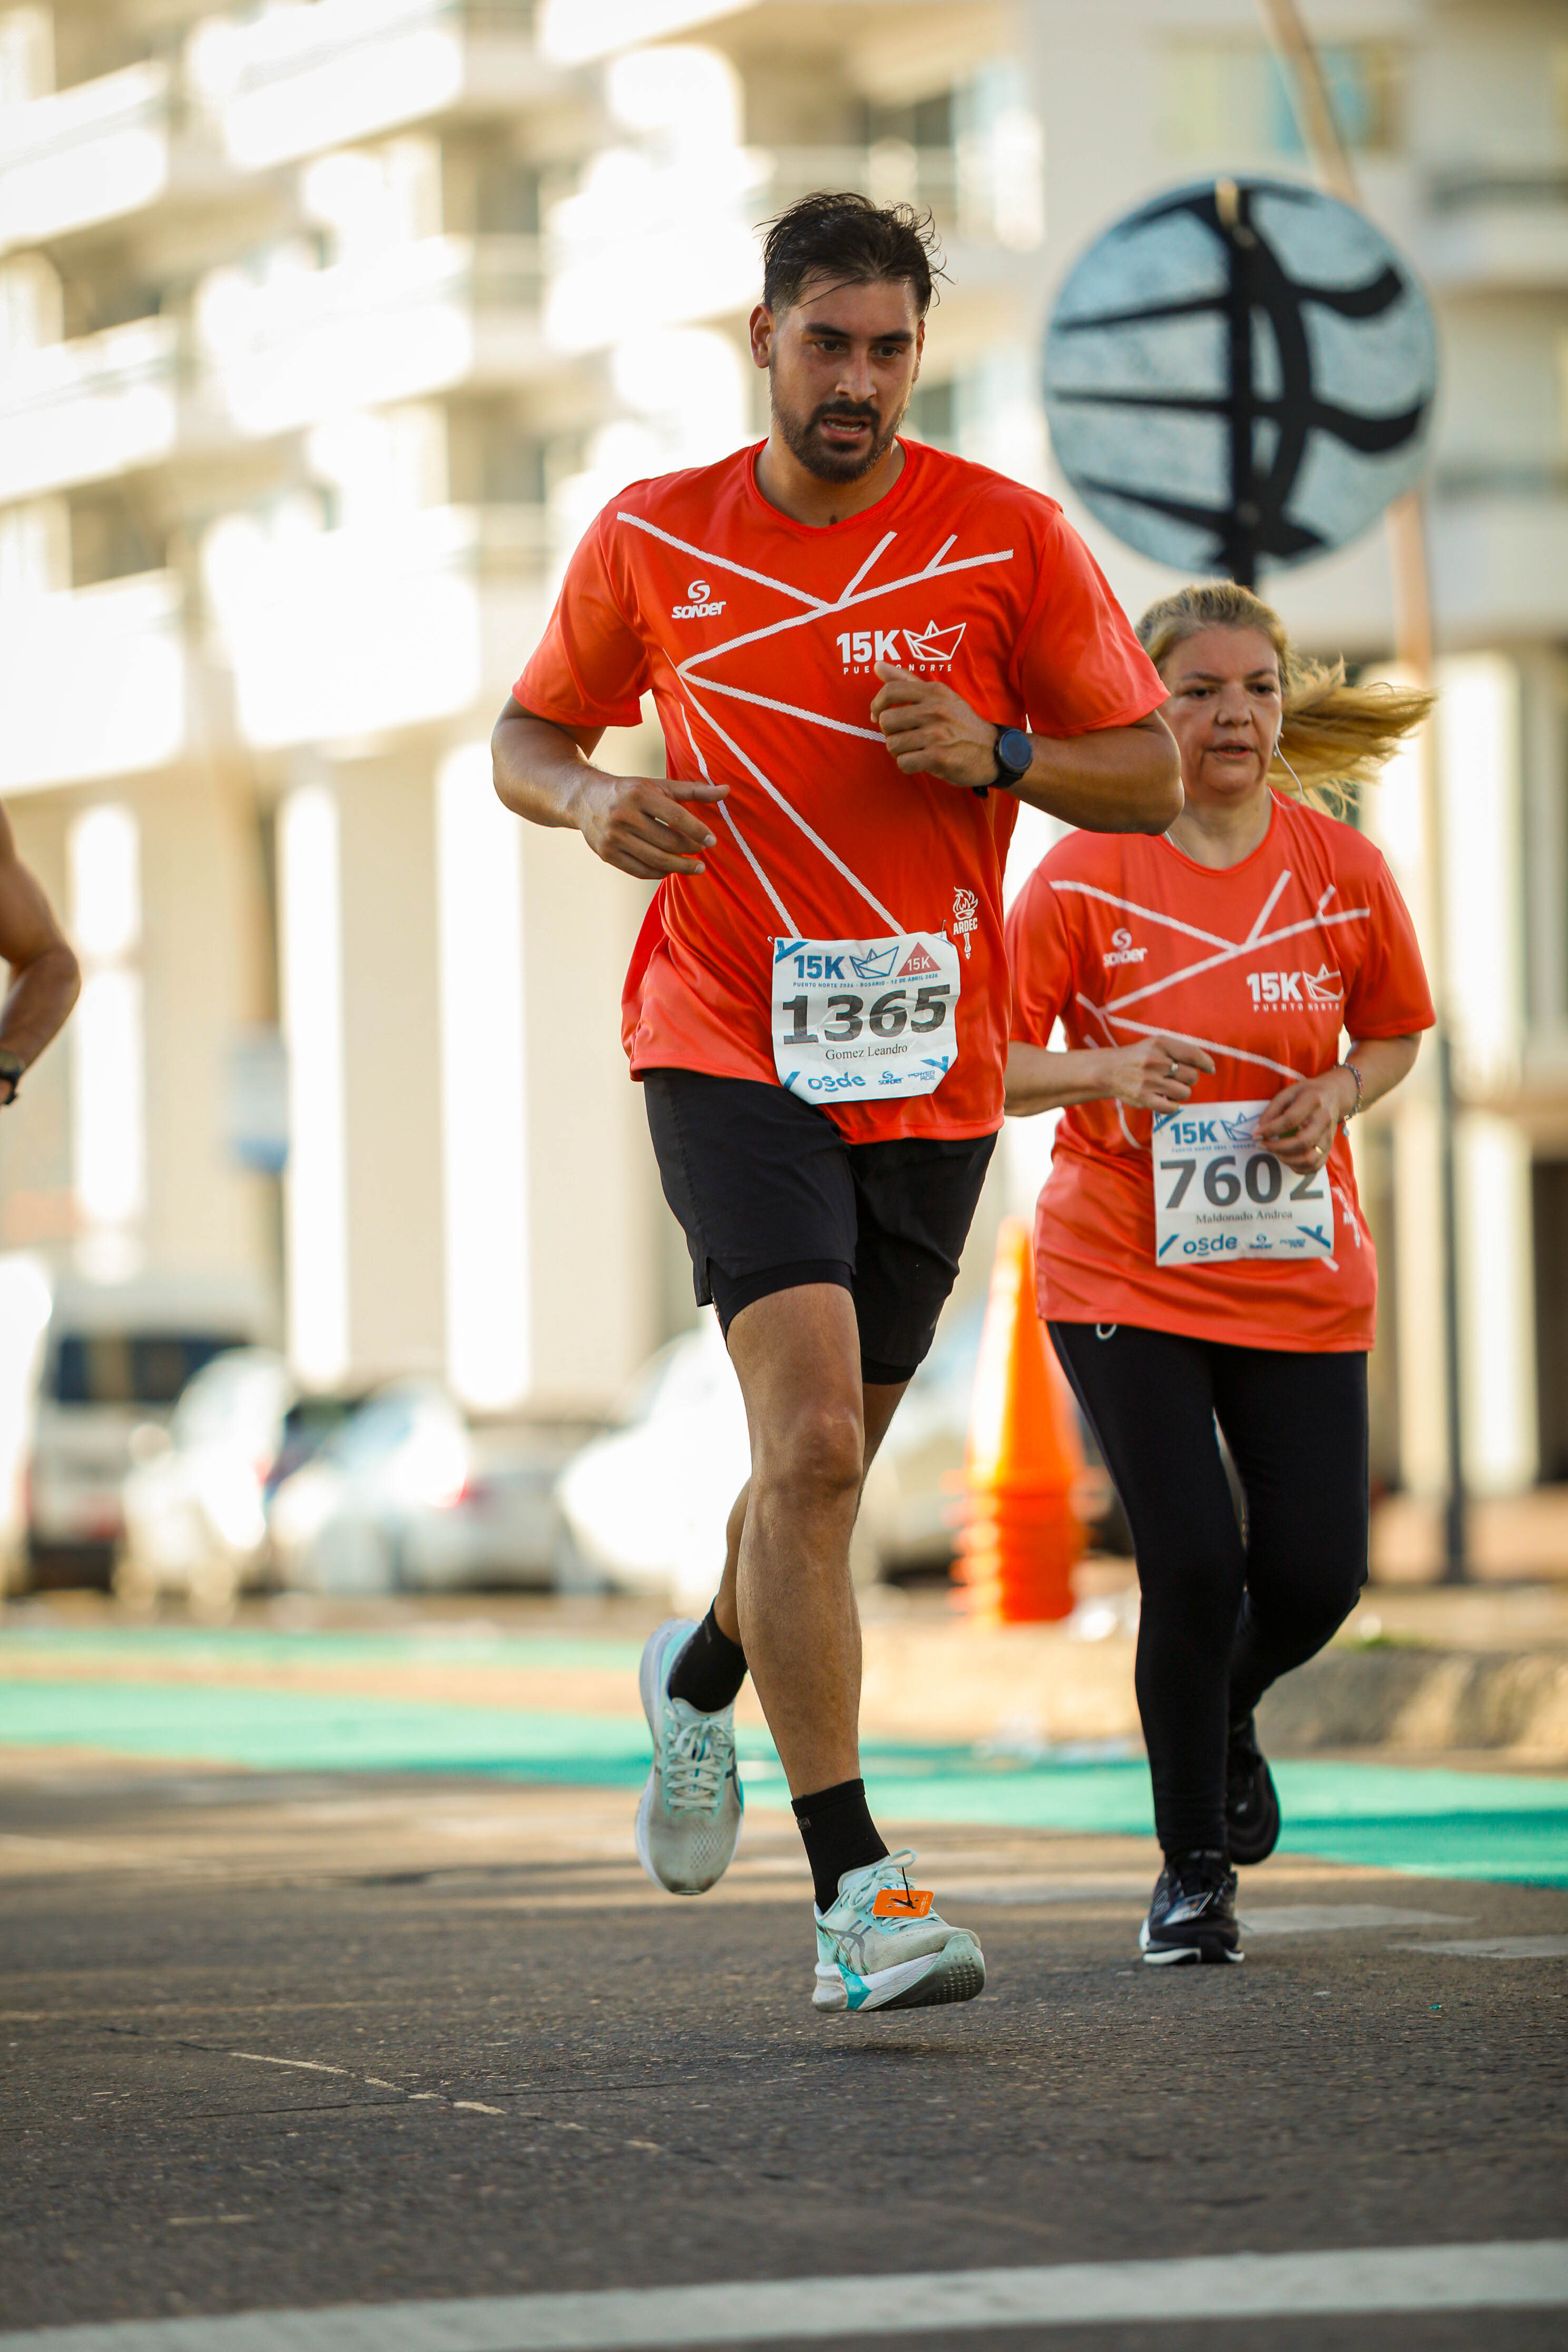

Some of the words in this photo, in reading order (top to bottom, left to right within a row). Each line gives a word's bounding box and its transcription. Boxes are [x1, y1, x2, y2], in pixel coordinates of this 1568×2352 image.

[837, 630, 901, 663] 15K
[953, 917, 978, 936] ARDEC
[793, 955, 845, 980] 15K
[907, 955, 932, 972] 15K
[1247, 972, 1304, 1002] 15K
[782, 984, 950, 1045] 1365
[1253, 1003, 1304, 1012] PUERTO
[1308, 1003, 1340, 1012] NORTE
[826, 1049, 864, 1061] Gomez
[868, 1044, 908, 1057] Leandro
[808, 1072, 866, 1092] osde
[1170, 1120, 1218, 1145] 15K
[1160, 1153, 1324, 1209] 7602
[1196, 1212, 1253, 1224] Maldonado
[1256, 1209, 1293, 1220] Andrea
[1183, 1233, 1237, 1256] osde
